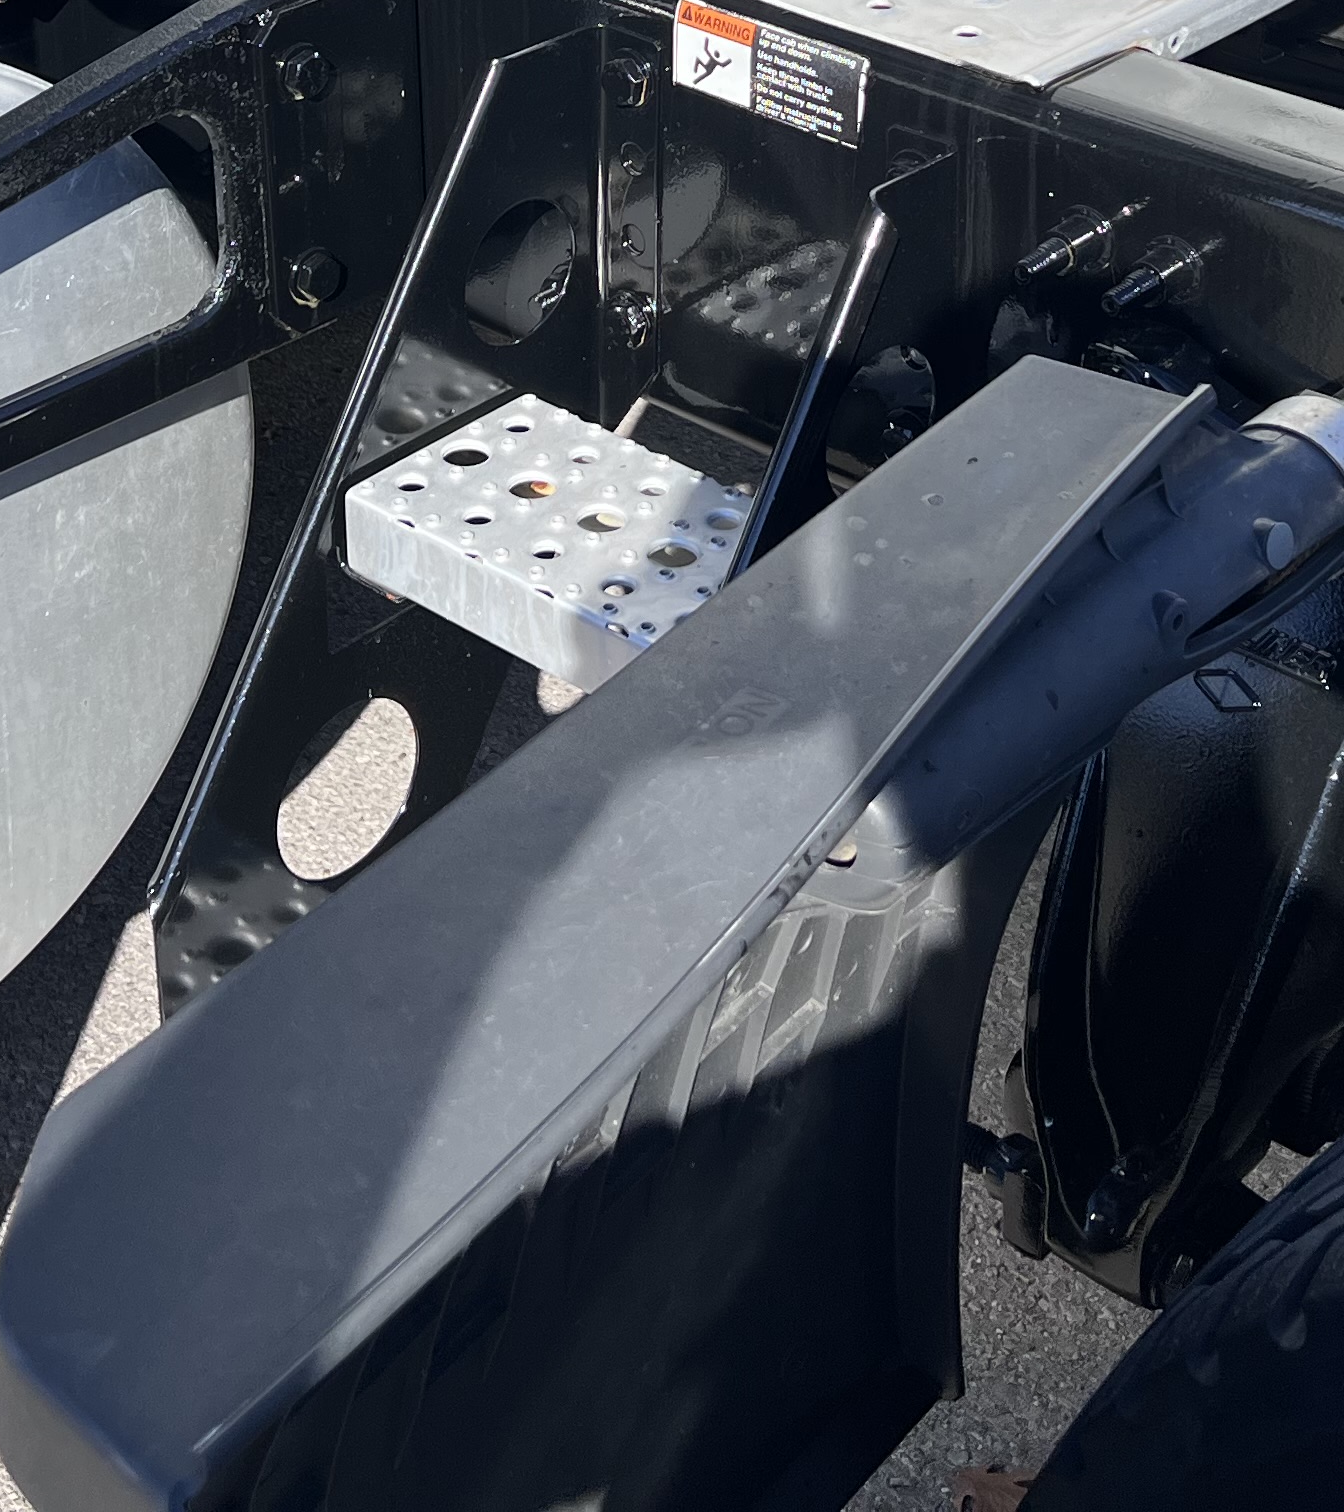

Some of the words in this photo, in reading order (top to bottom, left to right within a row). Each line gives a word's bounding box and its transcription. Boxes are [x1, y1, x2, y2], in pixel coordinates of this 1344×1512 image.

[694, 11, 751, 41] WARNING
[757, 49, 773, 62] Use
[774, 55, 818, 78] handholds.
[758, 38, 770, 48] up
[770, 42, 787, 53] and
[787, 48, 812, 62] down.
[760, 28, 780, 42] Face
[780, 36, 796, 47] cab
[797, 42, 819, 55] when
[820, 50, 856, 69] climbing
[756, 62, 777, 77] Keep
[779, 70, 800, 84] three
[825, 86, 833, 96] in
[756, 71, 787, 87] contact
[787, 82, 805, 93] with
[806, 88, 830, 102] truck.
[757, 83, 768, 94] Do
[769, 88, 783, 99] not
[784, 93, 805, 108] carry
[806, 102, 844, 121] anything.
[757, 96, 783, 112] Follow
[784, 105, 832, 129] instructions
[832, 121, 842, 133] in
